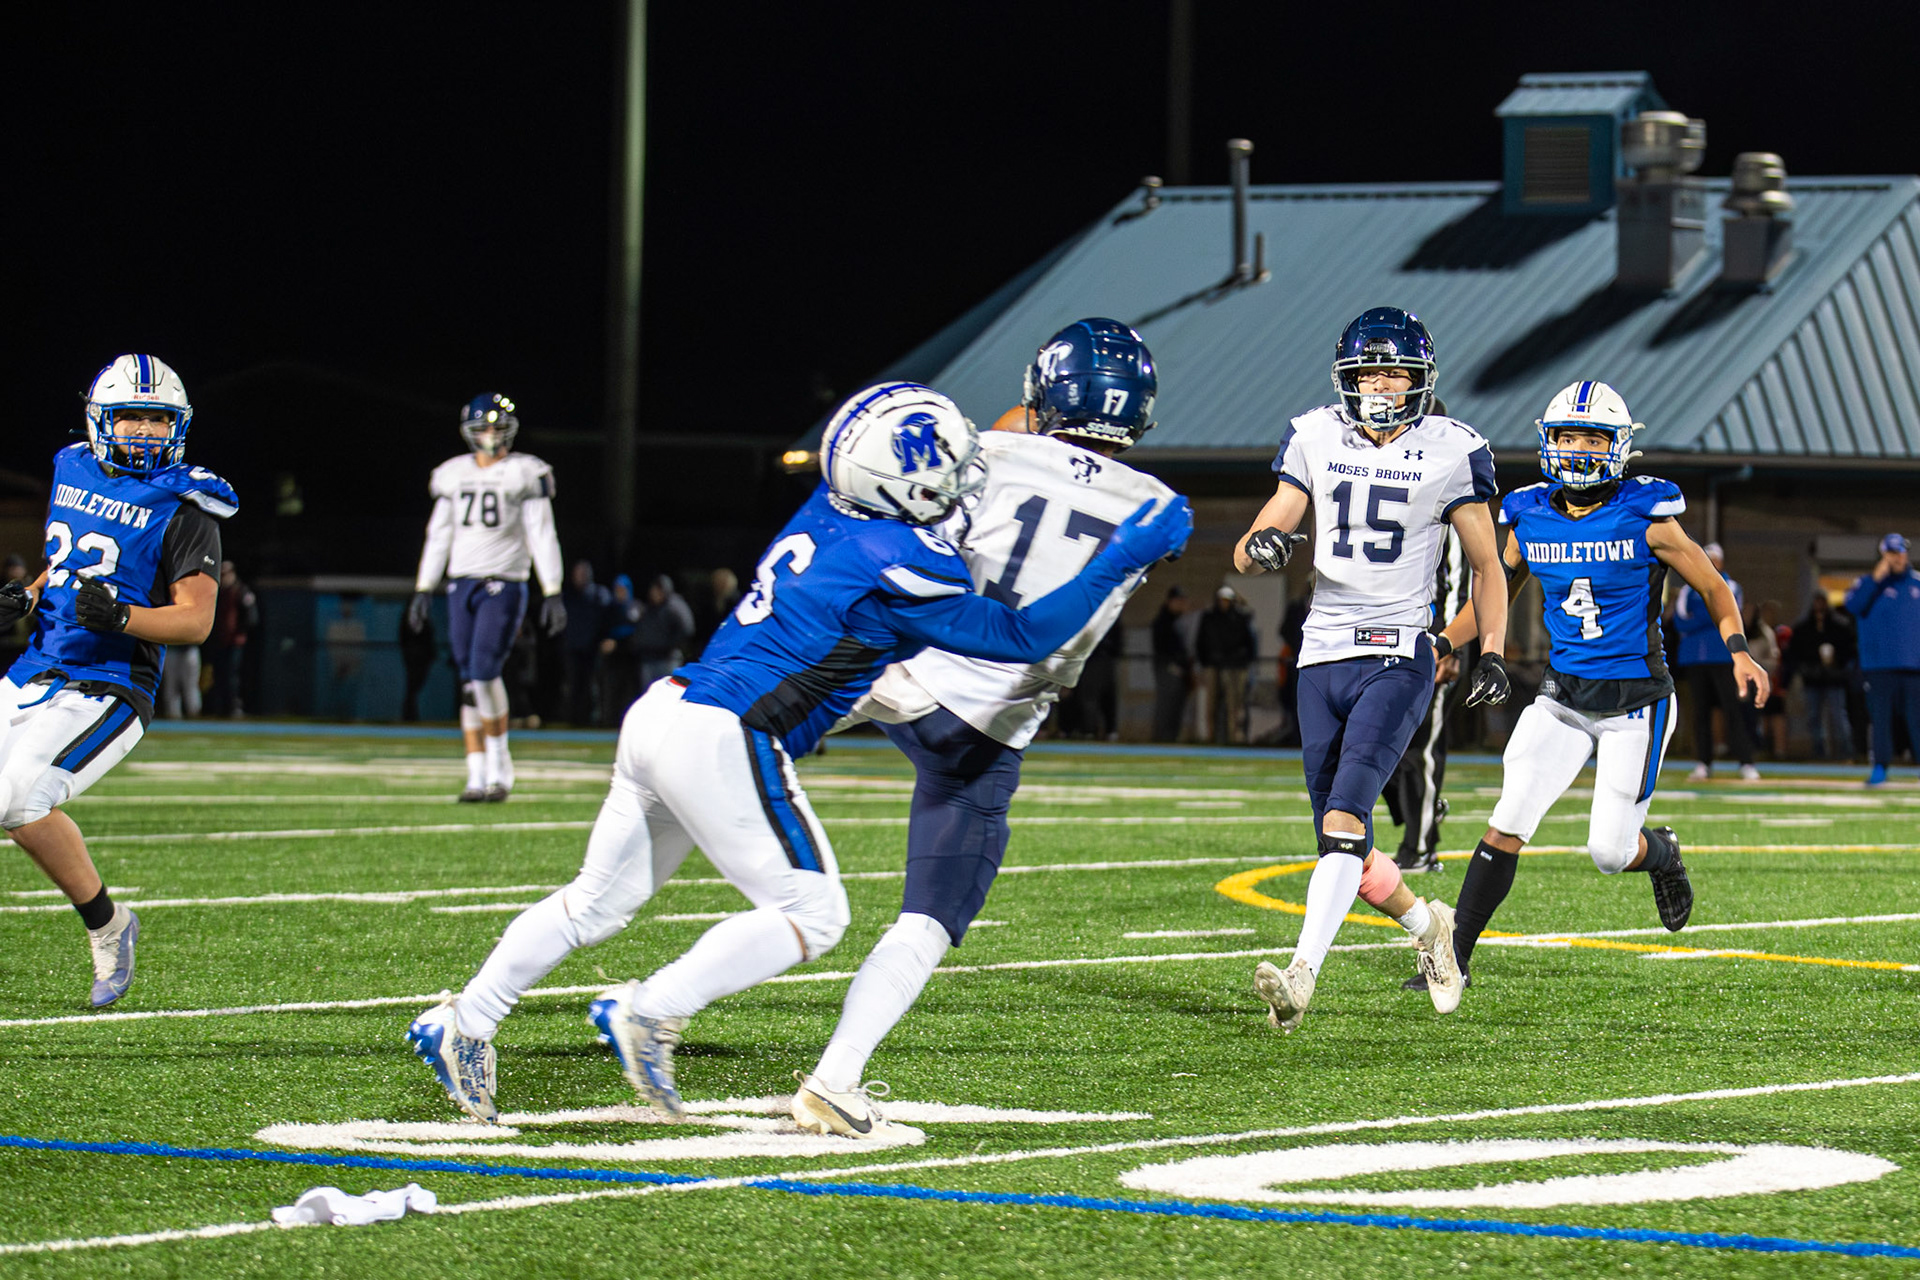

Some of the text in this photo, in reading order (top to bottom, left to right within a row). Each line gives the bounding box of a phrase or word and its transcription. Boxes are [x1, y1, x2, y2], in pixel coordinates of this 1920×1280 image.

[1102, 388, 1129, 416] 17
[899, 412, 943, 475] M
[1327, 461, 1423, 482] MOSES BROWN
[460, 491, 499, 528] 78
[1331, 480, 1406, 564] 15
[734, 532, 817, 627] 6
[982, 494, 1120, 611] 17
[1525, 539, 1635, 564] MIDDLETOWN
[1560, 577, 1604, 640] 4
